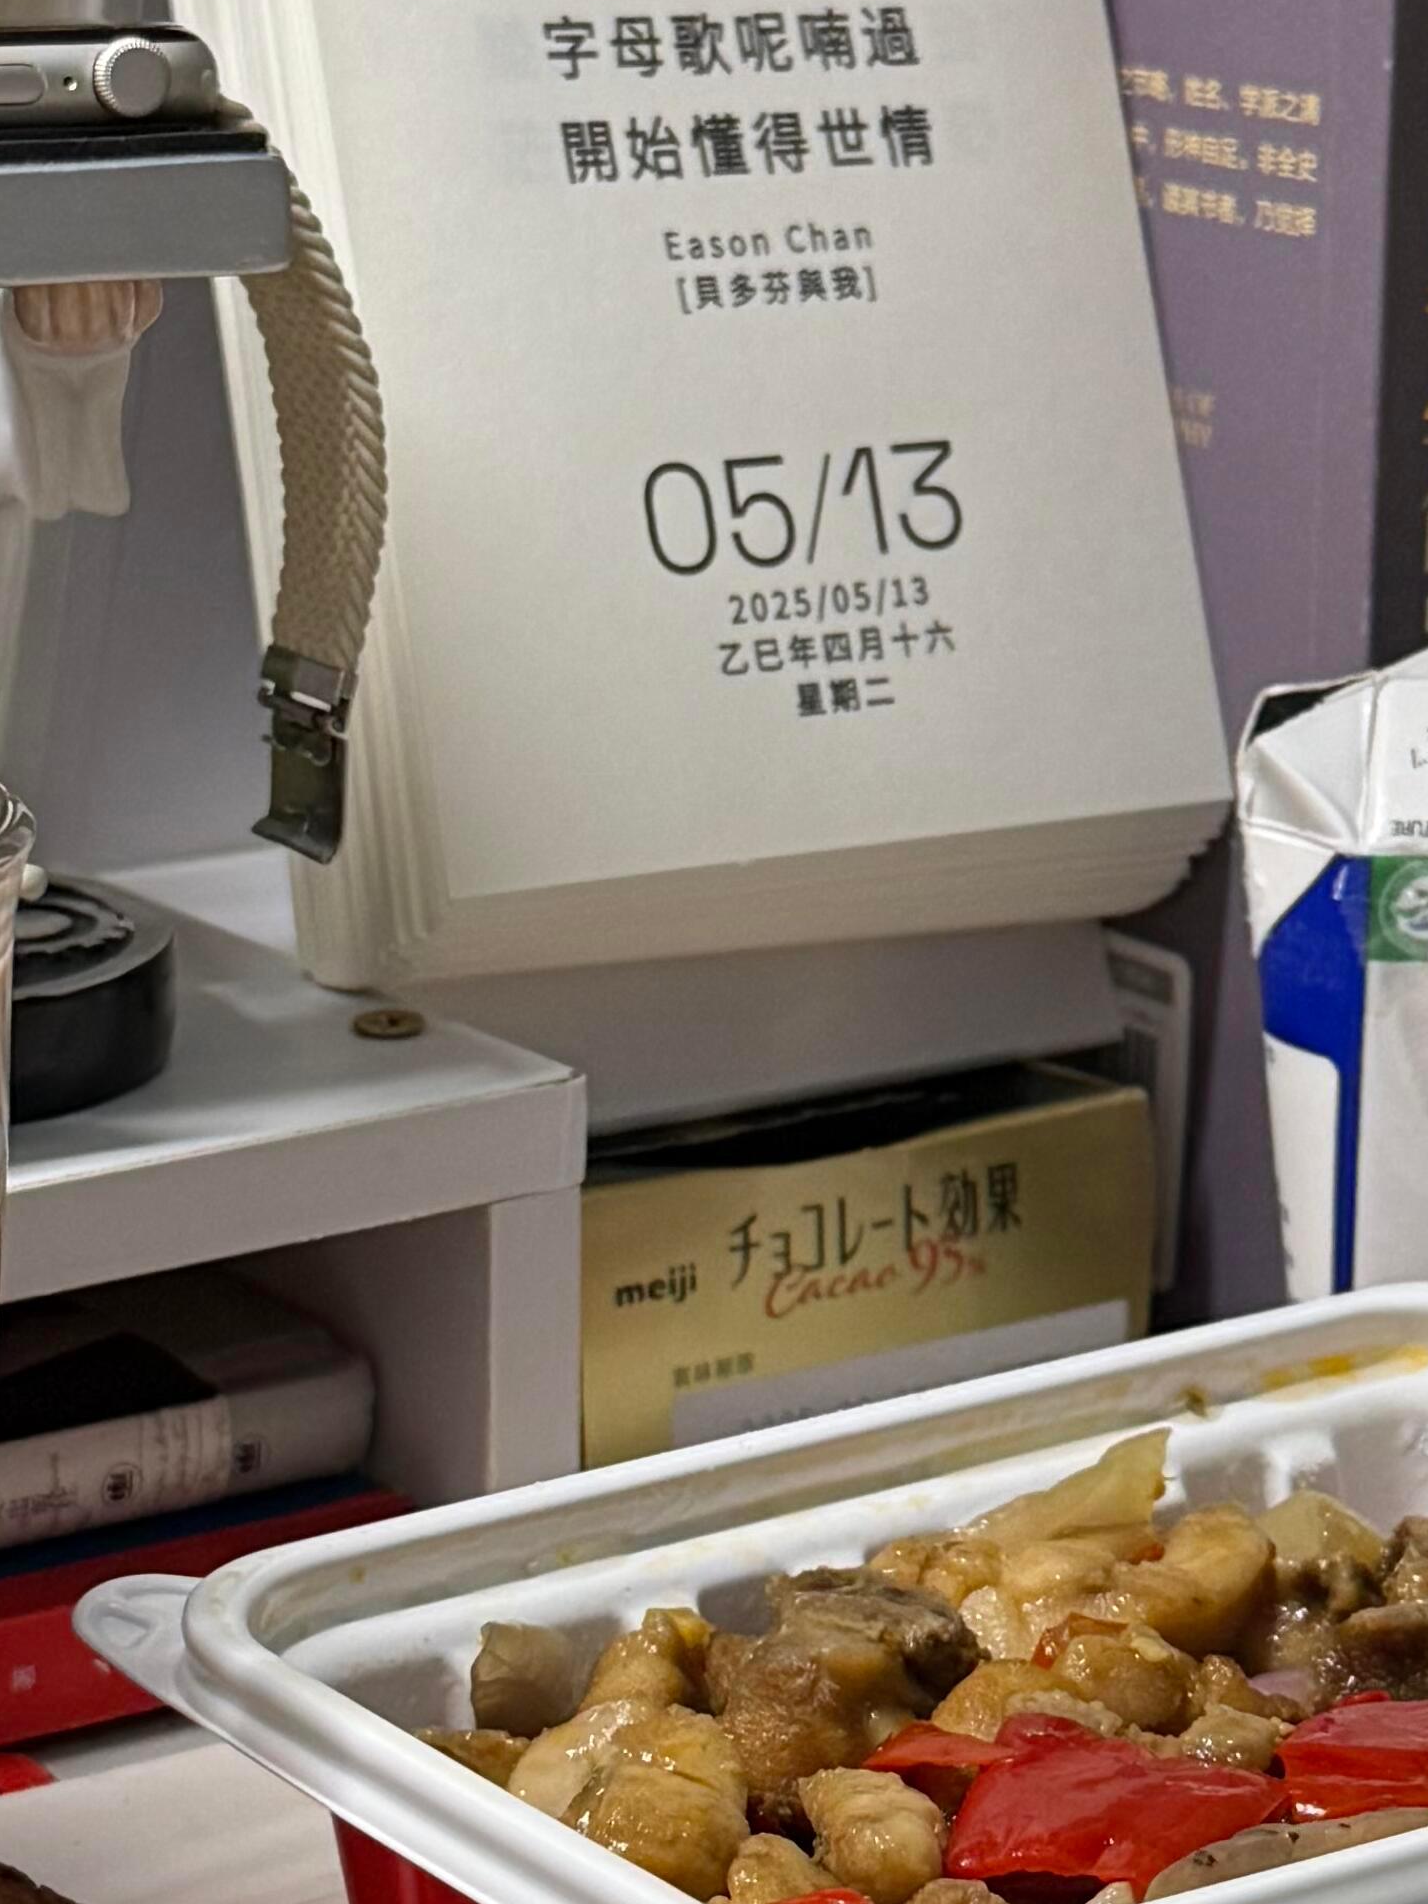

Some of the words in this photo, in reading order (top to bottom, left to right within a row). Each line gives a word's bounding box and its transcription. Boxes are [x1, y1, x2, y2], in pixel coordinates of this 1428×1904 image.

[542, 6, 919, 80] 字母歌呢喃過
[560, 104, 934, 183] 開始懂得世情
[664, 229, 771, 261] Eason
[785, 220, 874, 253] Chan
[678, 264, 878, 314] [貝多芬與我]
[644, 439, 963, 576] 05/13
[729, 576, 930, 625] 2025/05/13
[718, 620, 956, 676] 乙巳年四月十六
[797, 677, 896, 717] 星期二
[614, 1263, 698, 1308] meiji
[765, 1262, 897, 1320] Cacao
